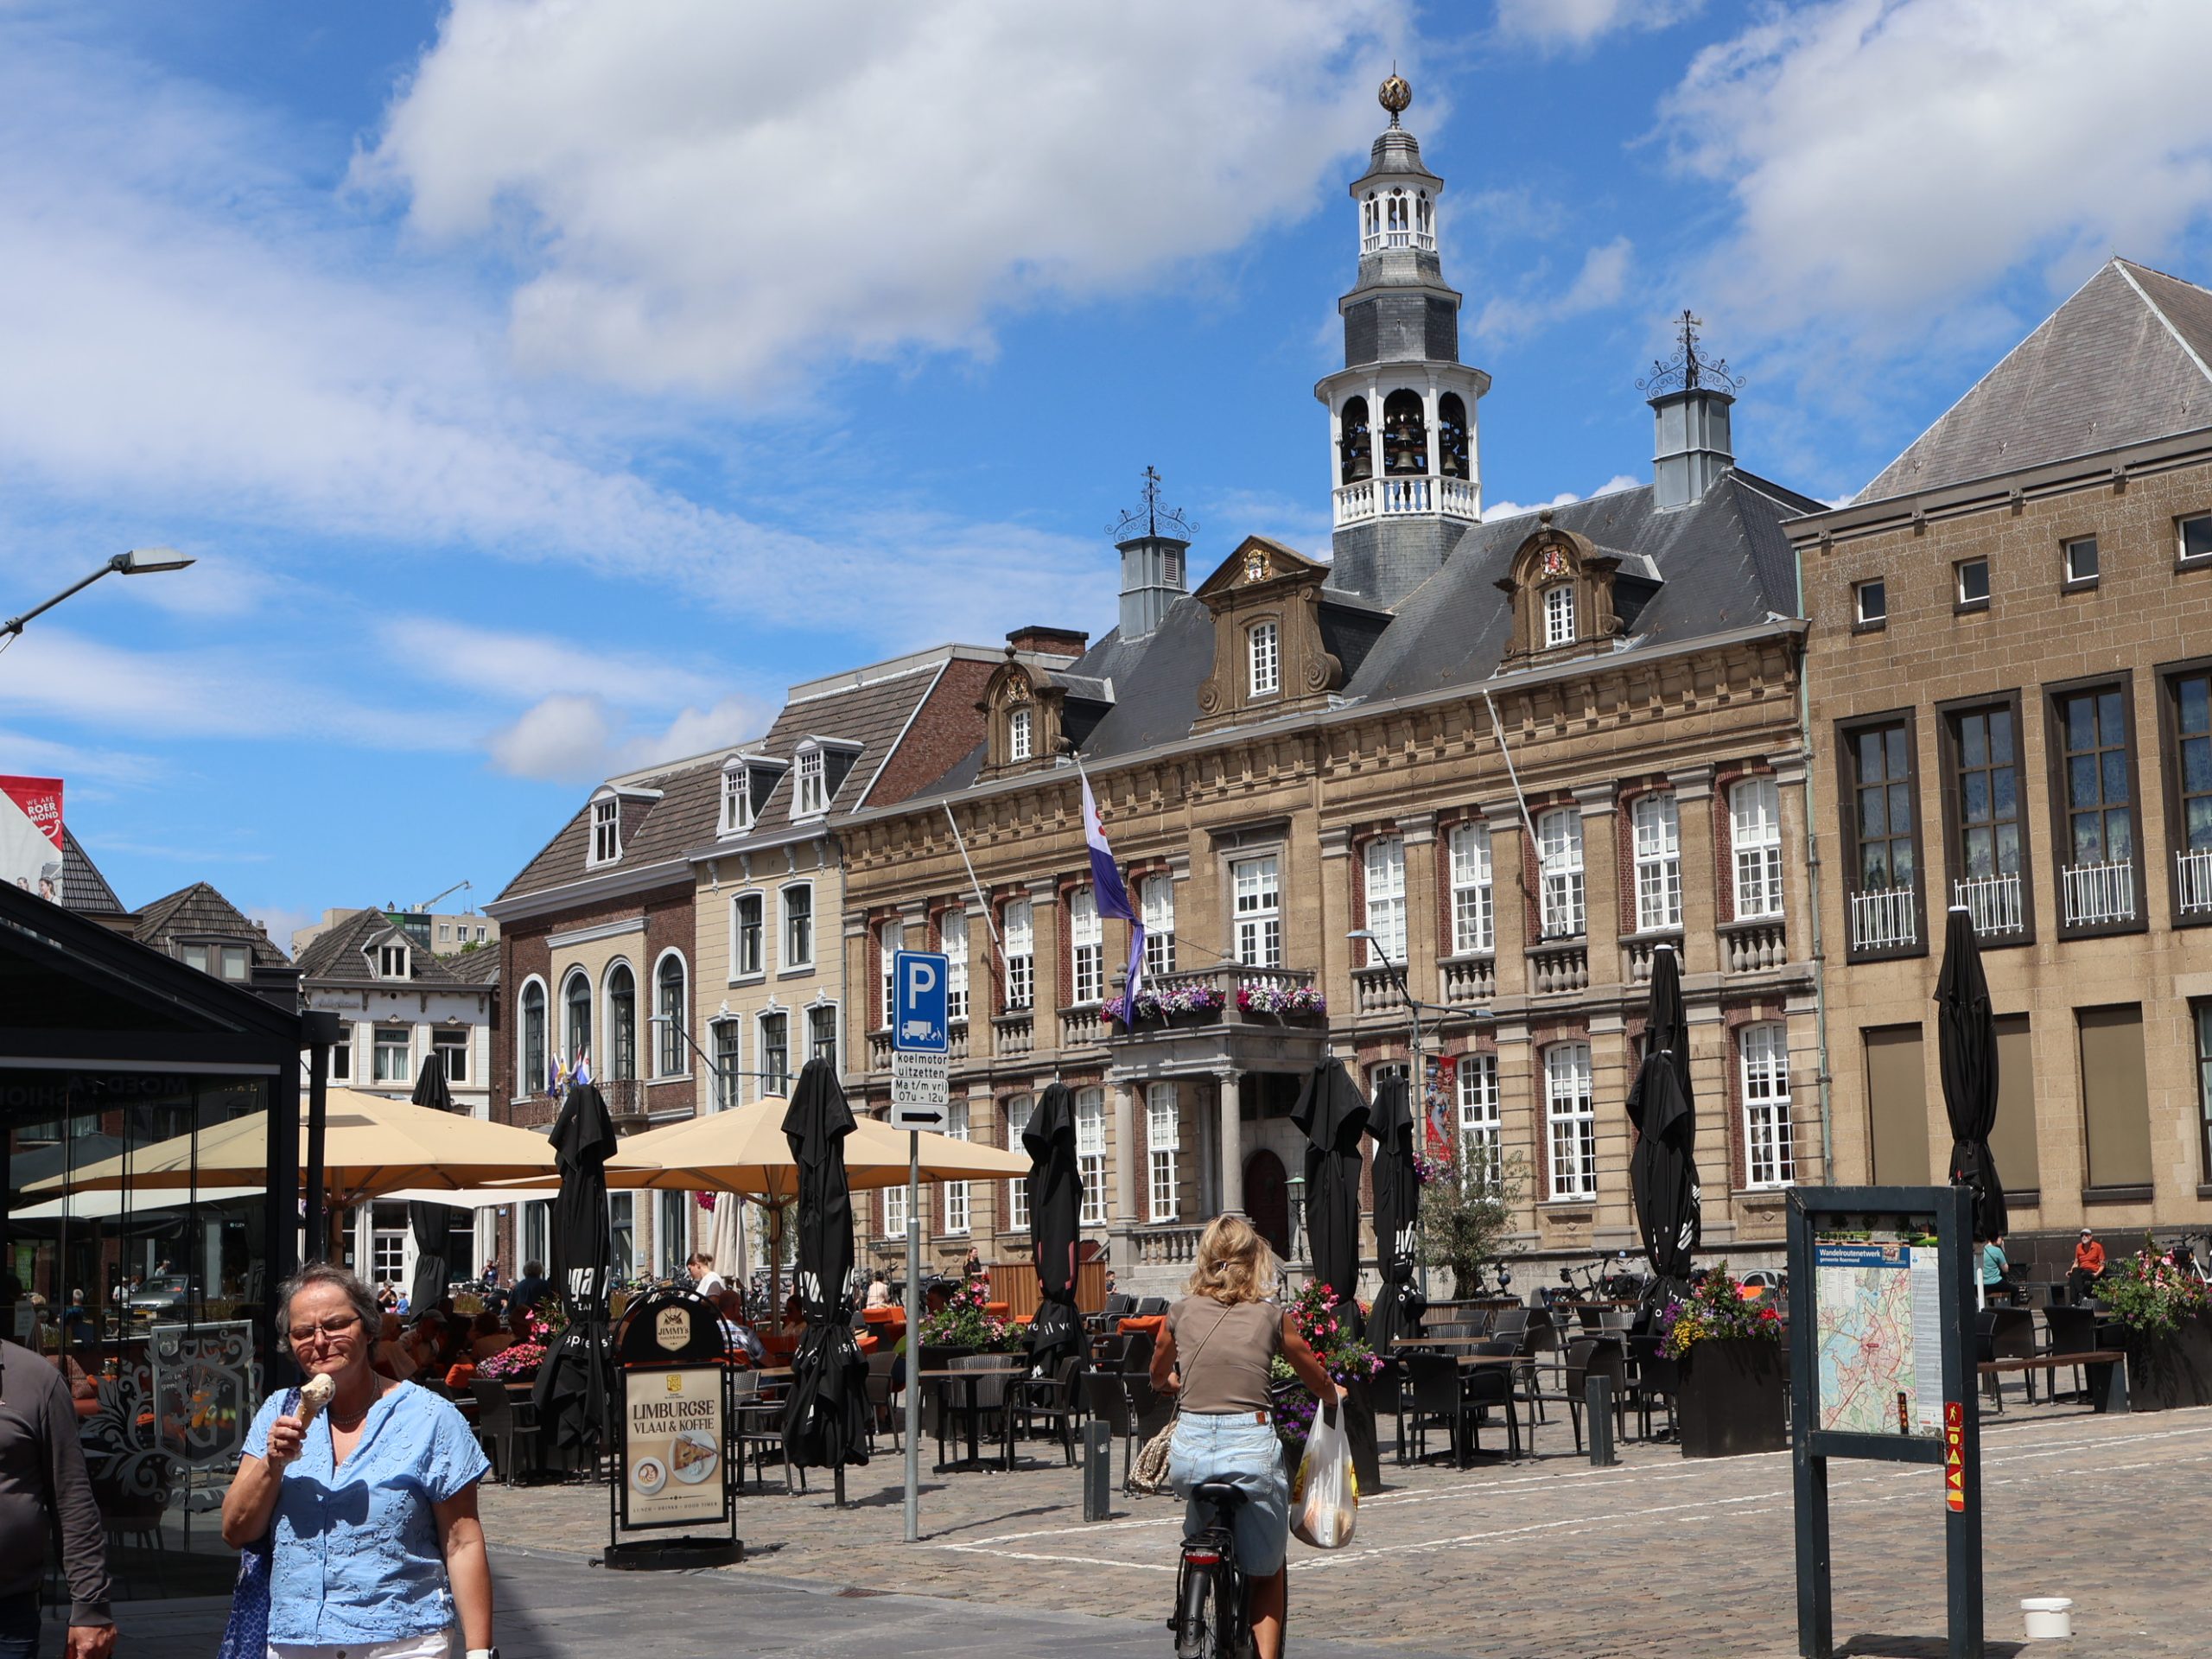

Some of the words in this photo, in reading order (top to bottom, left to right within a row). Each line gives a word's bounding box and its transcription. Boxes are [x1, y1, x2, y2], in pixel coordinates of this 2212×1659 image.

[28, 802, 57, 816] ROER
[29, 811, 58, 822] MOND
[909, 962, 936, 1009] P
[898, 1052, 948, 1065] koelmotor
[899, 1065, 944, 1078] uitzetten
[895, 1079, 909, 1090] Ma
[912, 1080, 929, 1090] t/m
[931, 1081, 948, 1095] vrij
[899, 1091, 917, 1102] 07u
[928, 1092, 944, 1103] 12u
[1819, 1248, 1881, 1257] Wandelroutenetwerk
[658, 1325, 689, 1336] JIMMY's
[633, 1400, 715, 1420] LIMBURGSE
[633, 1421, 666, 1434] VLAAI
[669, 1421, 677, 1433] &
[679, 1418, 715, 1432] KOFFIE
